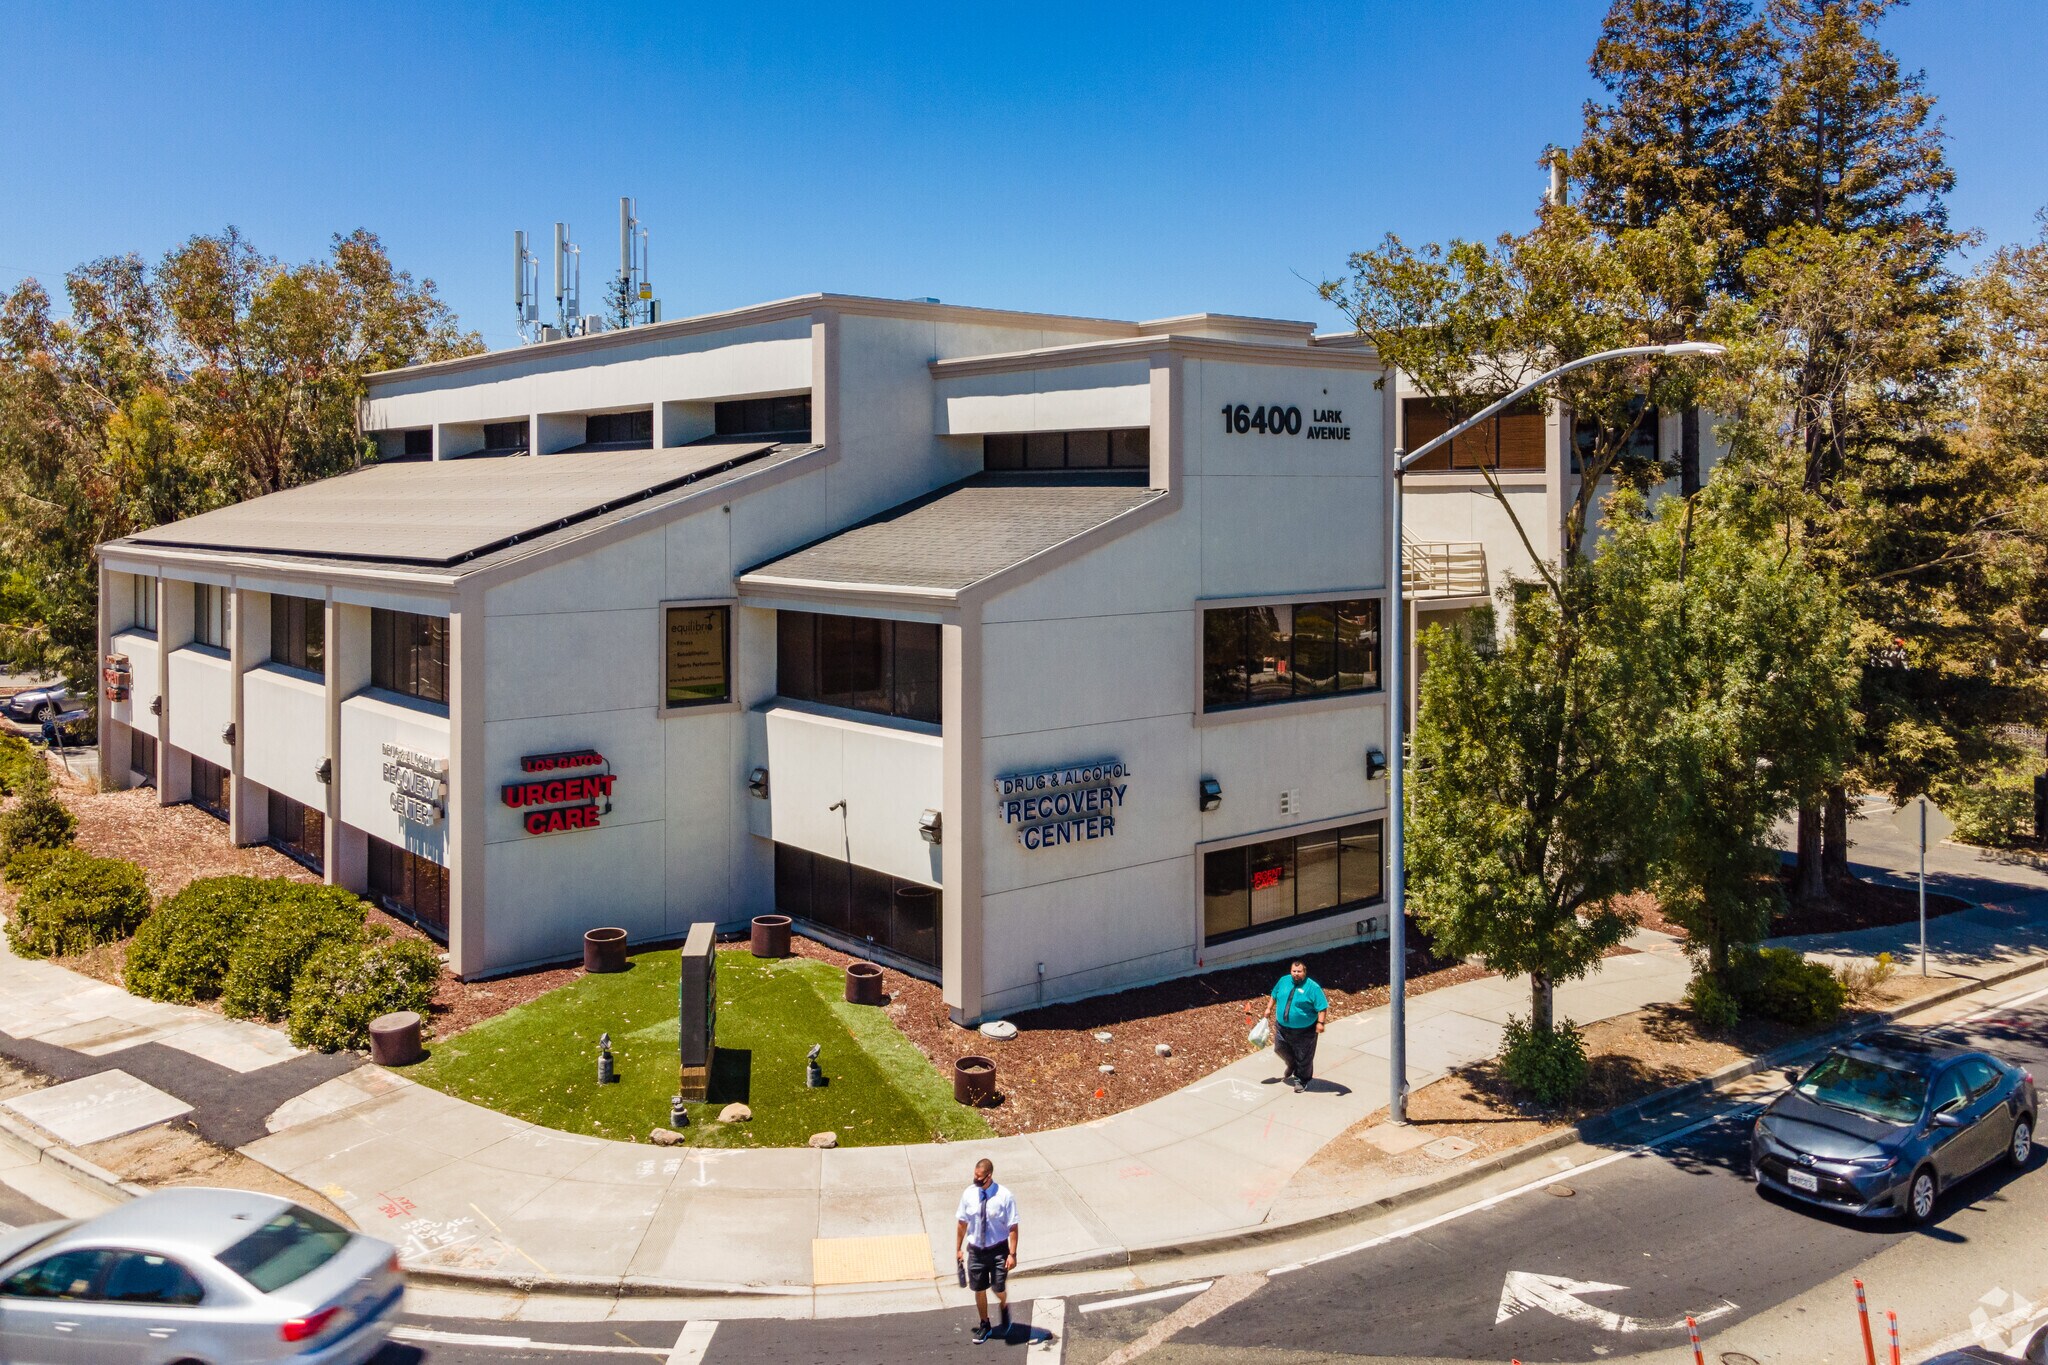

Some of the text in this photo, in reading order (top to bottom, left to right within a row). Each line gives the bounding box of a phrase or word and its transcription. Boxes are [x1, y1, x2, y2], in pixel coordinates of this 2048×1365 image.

[1221, 404, 1302, 435] 16400
[1313, 409, 1342, 423] LARK
[1307, 426, 1351, 440] AVENUE
[526, 753, 603, 773] LOS GATOS
[505, 774, 618, 809] URGENT
[1003, 763, 1131, 795] DRUG & ALCOHOL
[1006, 783, 1128, 824] RECOVERY
[526, 804, 601, 835] CARE
[1024, 815, 1114, 850] CENTER
